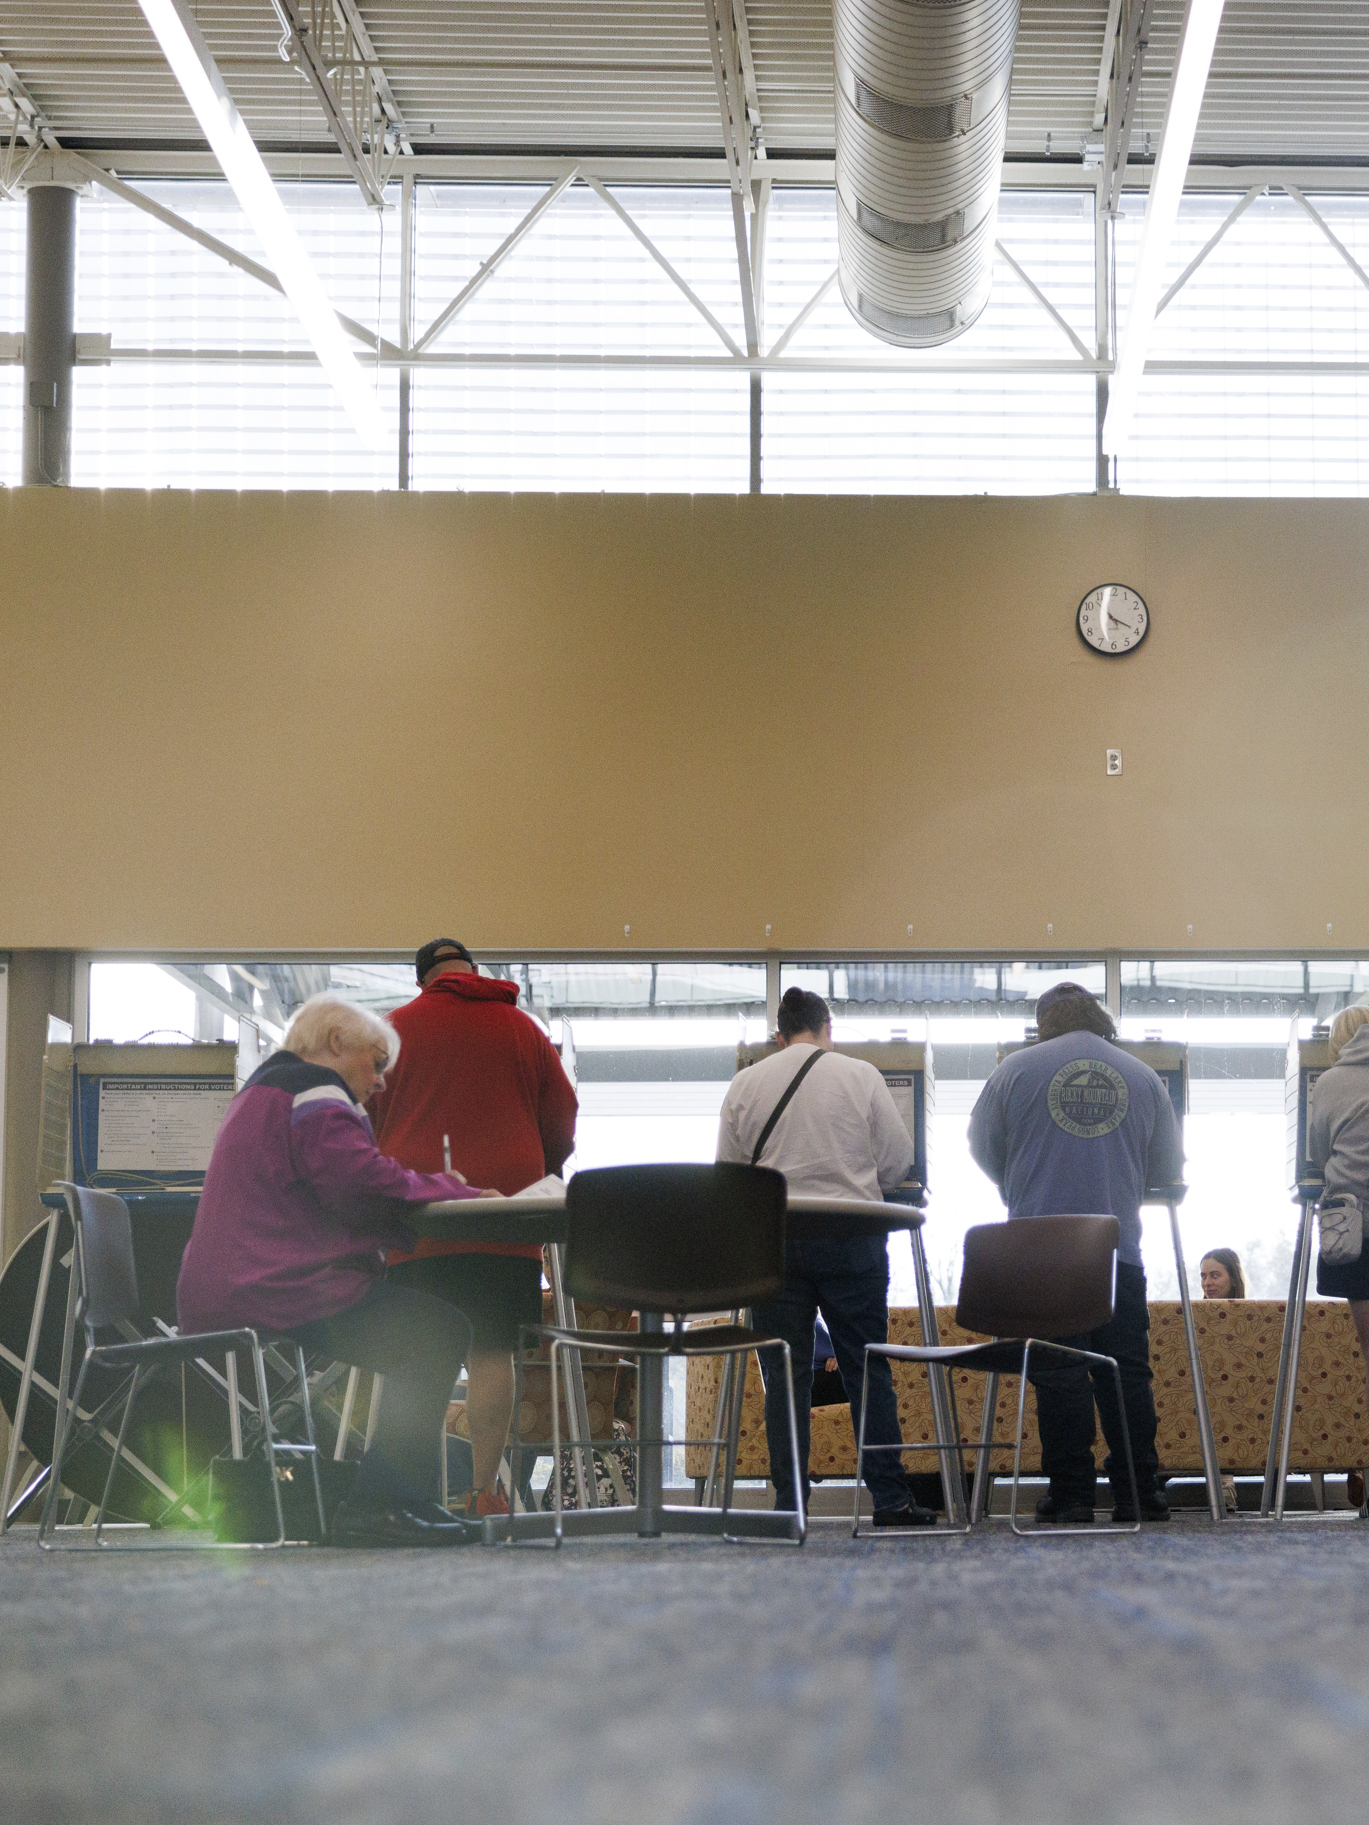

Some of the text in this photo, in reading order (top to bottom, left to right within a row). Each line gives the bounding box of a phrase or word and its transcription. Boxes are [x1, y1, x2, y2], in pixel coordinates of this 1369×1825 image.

[1096, 592, 1103, 601] 11
[1124, 592, 1128, 600] 1
[1084, 602, 1094, 610] 10
[1133, 601, 1139, 610] 2
[1082, 615, 1088, 624] 9
[1138, 614, 1144, 623] 3
[1086, 628, 1093, 636] 8
[1134, 628, 1140, 636] 4
[1098, 638, 1104, 647] 7
[1110, 641, 1117, 650] 6
[1124, 638, 1130, 646] 5
[1058, 1062, 1080, 1079] FALLS
[1088, 1061, 1126, 1090] BEAR LAKE
[1061, 1086, 1117, 1105] ROCKY MOUNTAIN
[1065, 1106, 1110, 1117] NATIONAL
[1058, 1114, 1077, 1132] PEAK
